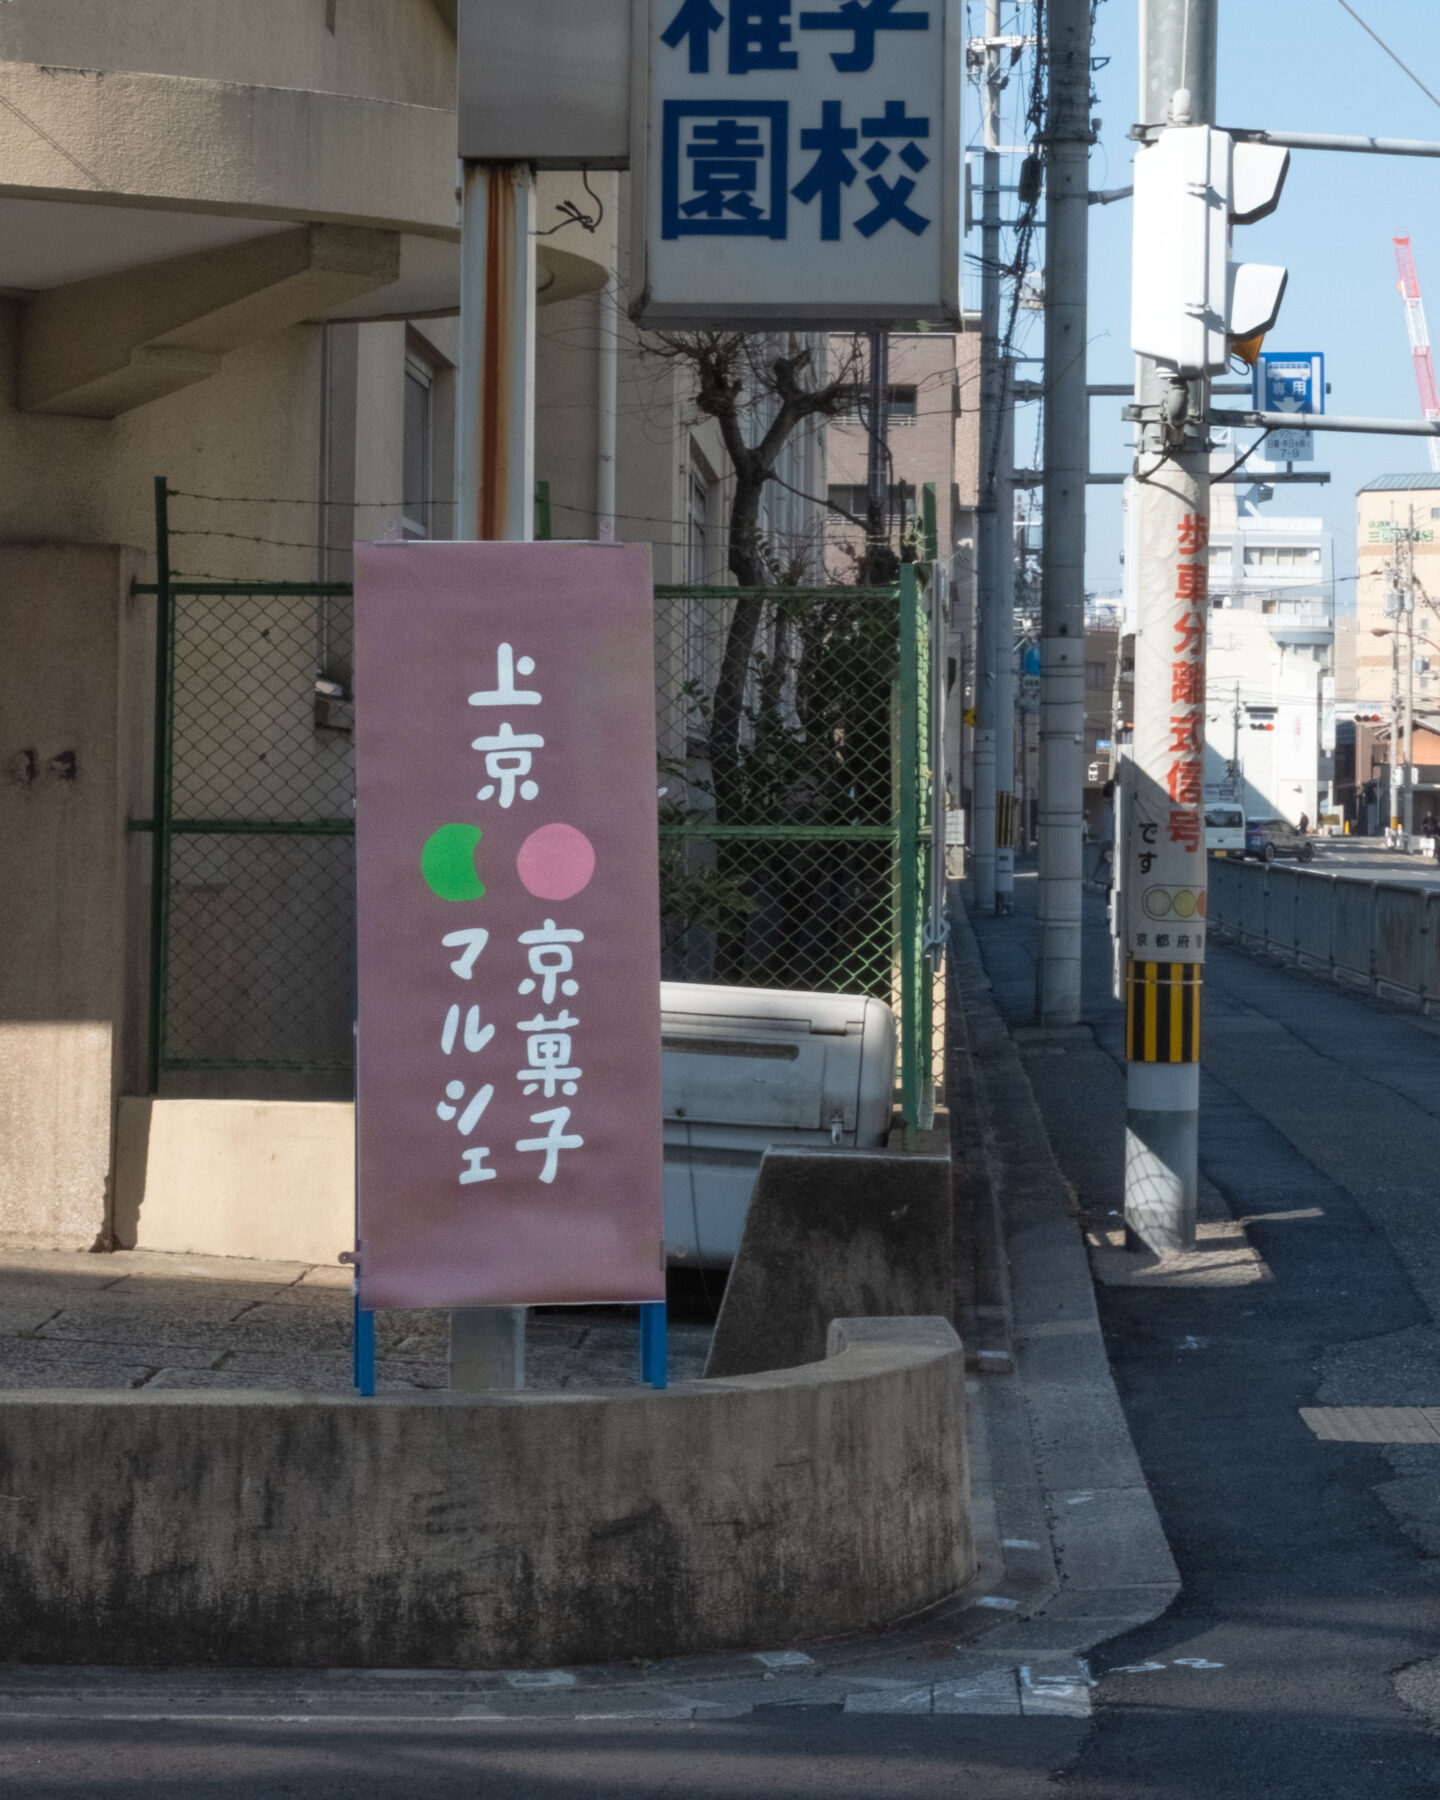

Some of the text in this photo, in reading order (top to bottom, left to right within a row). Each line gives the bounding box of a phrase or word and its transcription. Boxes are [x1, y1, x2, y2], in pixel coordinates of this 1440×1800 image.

[467, 642, 545, 808] 上京
[1166, 513, 1209, 853] 歩車分離式信号
[1138, 822, 1158, 874] です
[436, 927, 497, 1185] マルシェ
[516, 919, 585, 1184] 京菓子
